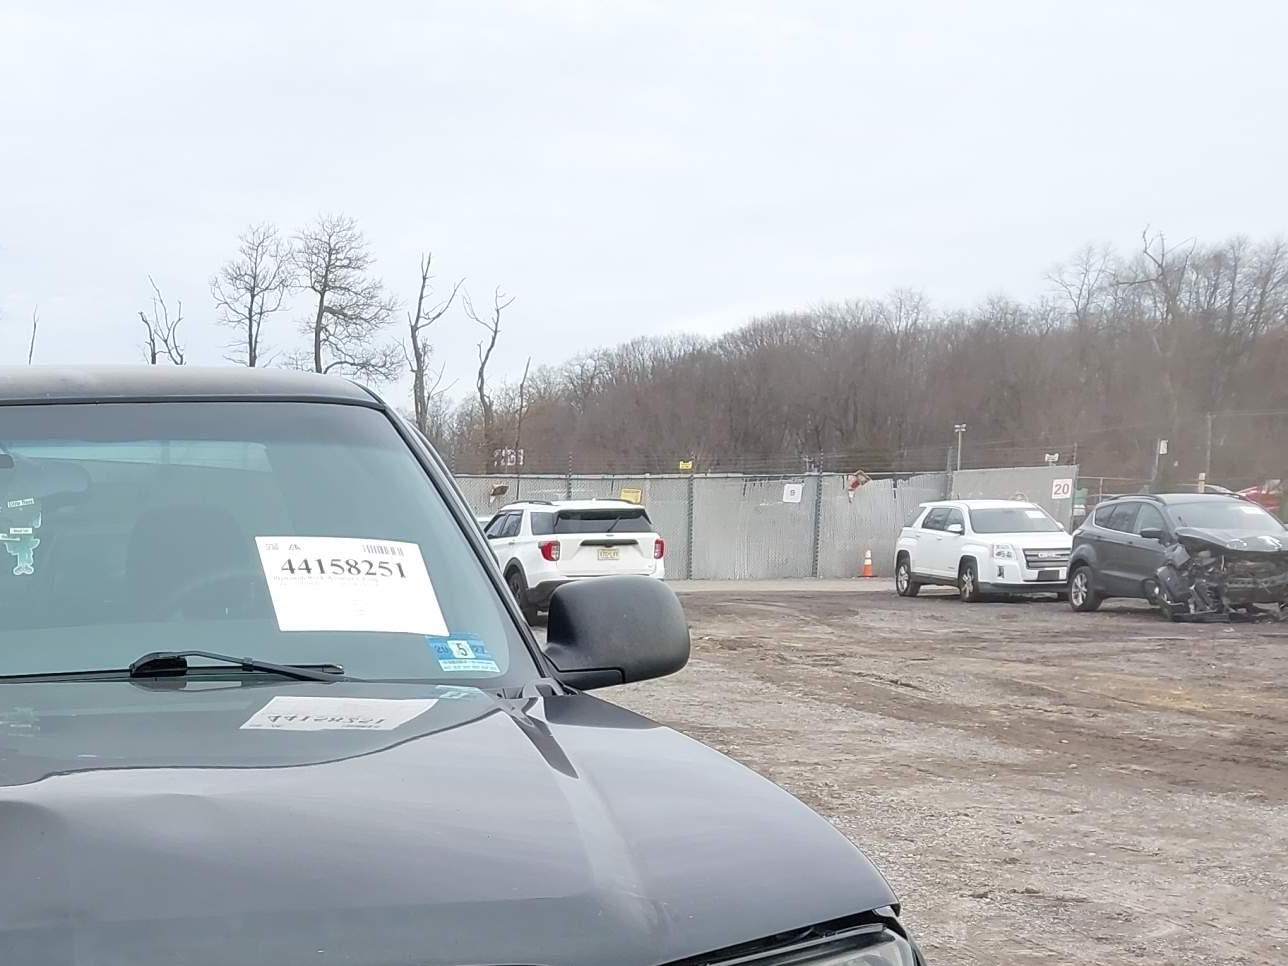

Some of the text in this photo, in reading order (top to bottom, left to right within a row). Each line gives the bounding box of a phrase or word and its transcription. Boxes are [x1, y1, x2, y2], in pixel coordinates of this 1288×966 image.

[1054, 483, 1070, 495] 20
[281, 558, 406, 578] 44158251
[456, 643, 468, 656] 5
